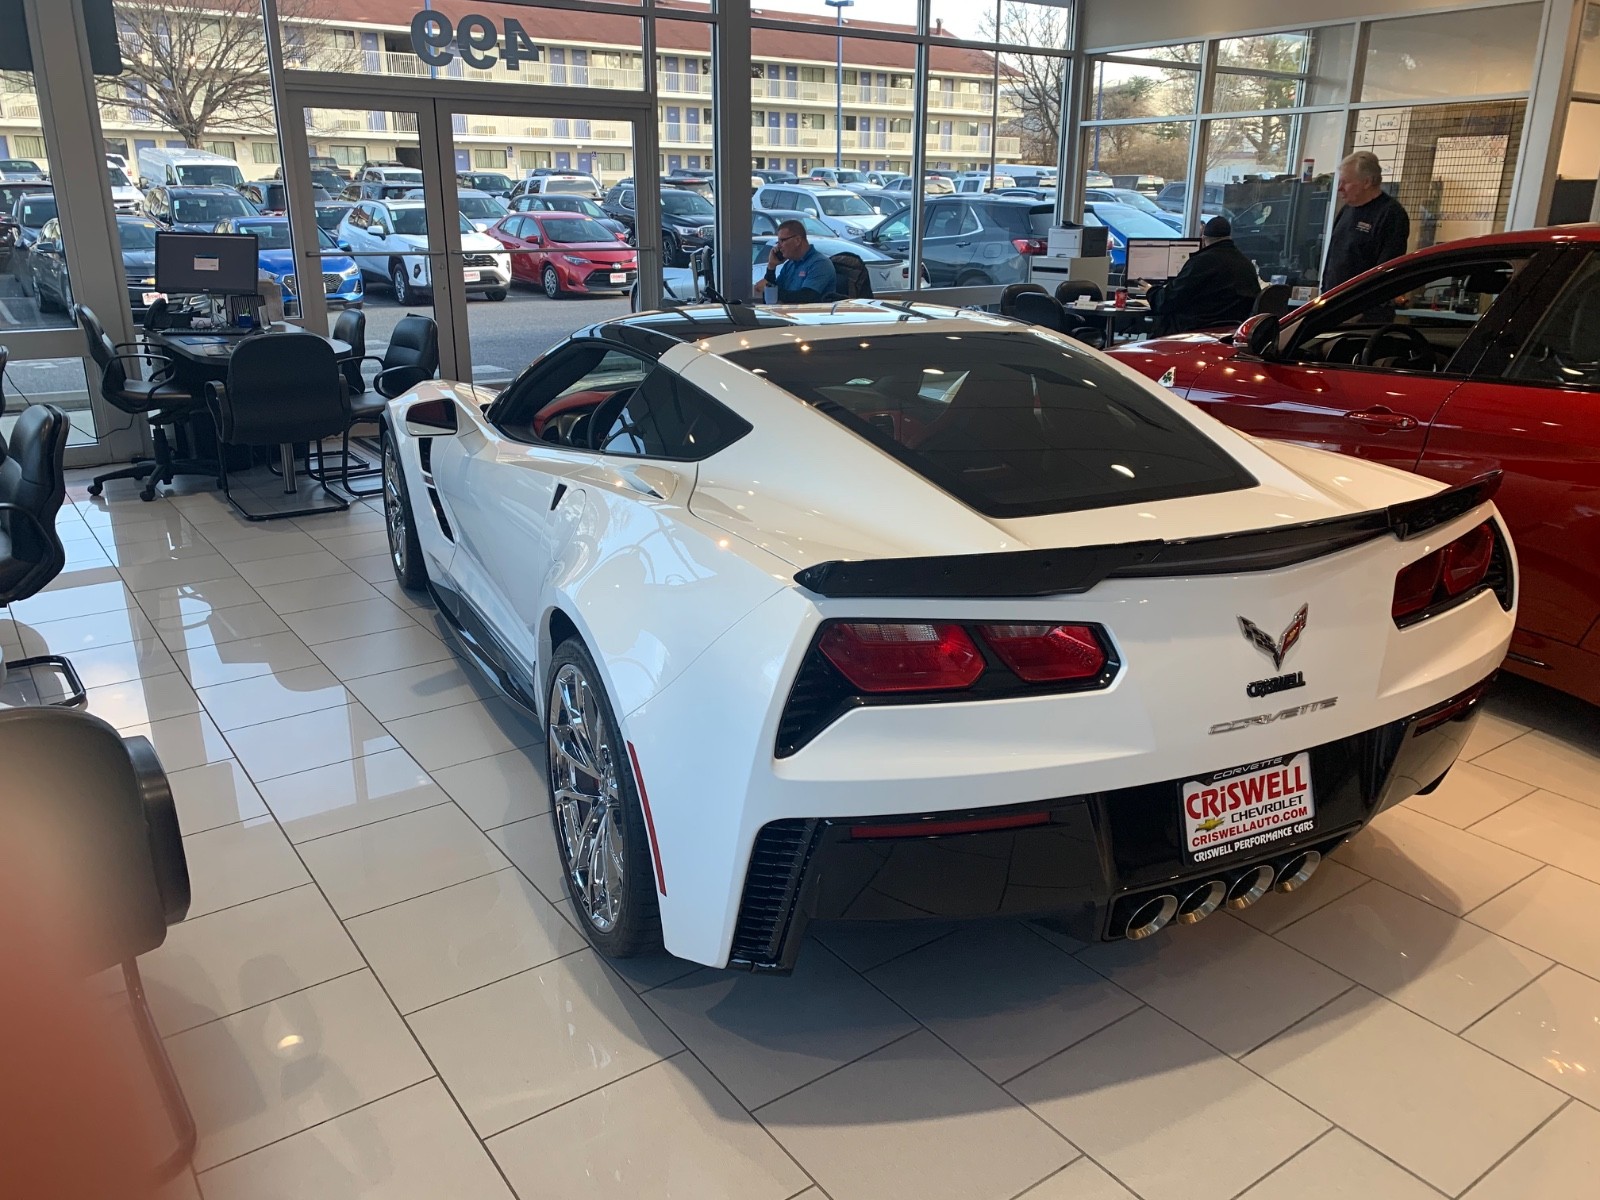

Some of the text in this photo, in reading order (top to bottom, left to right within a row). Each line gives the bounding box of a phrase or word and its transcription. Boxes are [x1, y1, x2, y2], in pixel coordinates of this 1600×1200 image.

[1208, 696, 1339, 735] CORVETTE
[1213, 756, 1283, 780] CORVETTE
[1192, 806, 1308, 847] CRISWELLAUTO.COM
[1231, 795, 1304, 823] CHEVROLET
[1193, 821, 1314, 862] CRISWELL PERFORMANCE CARS
